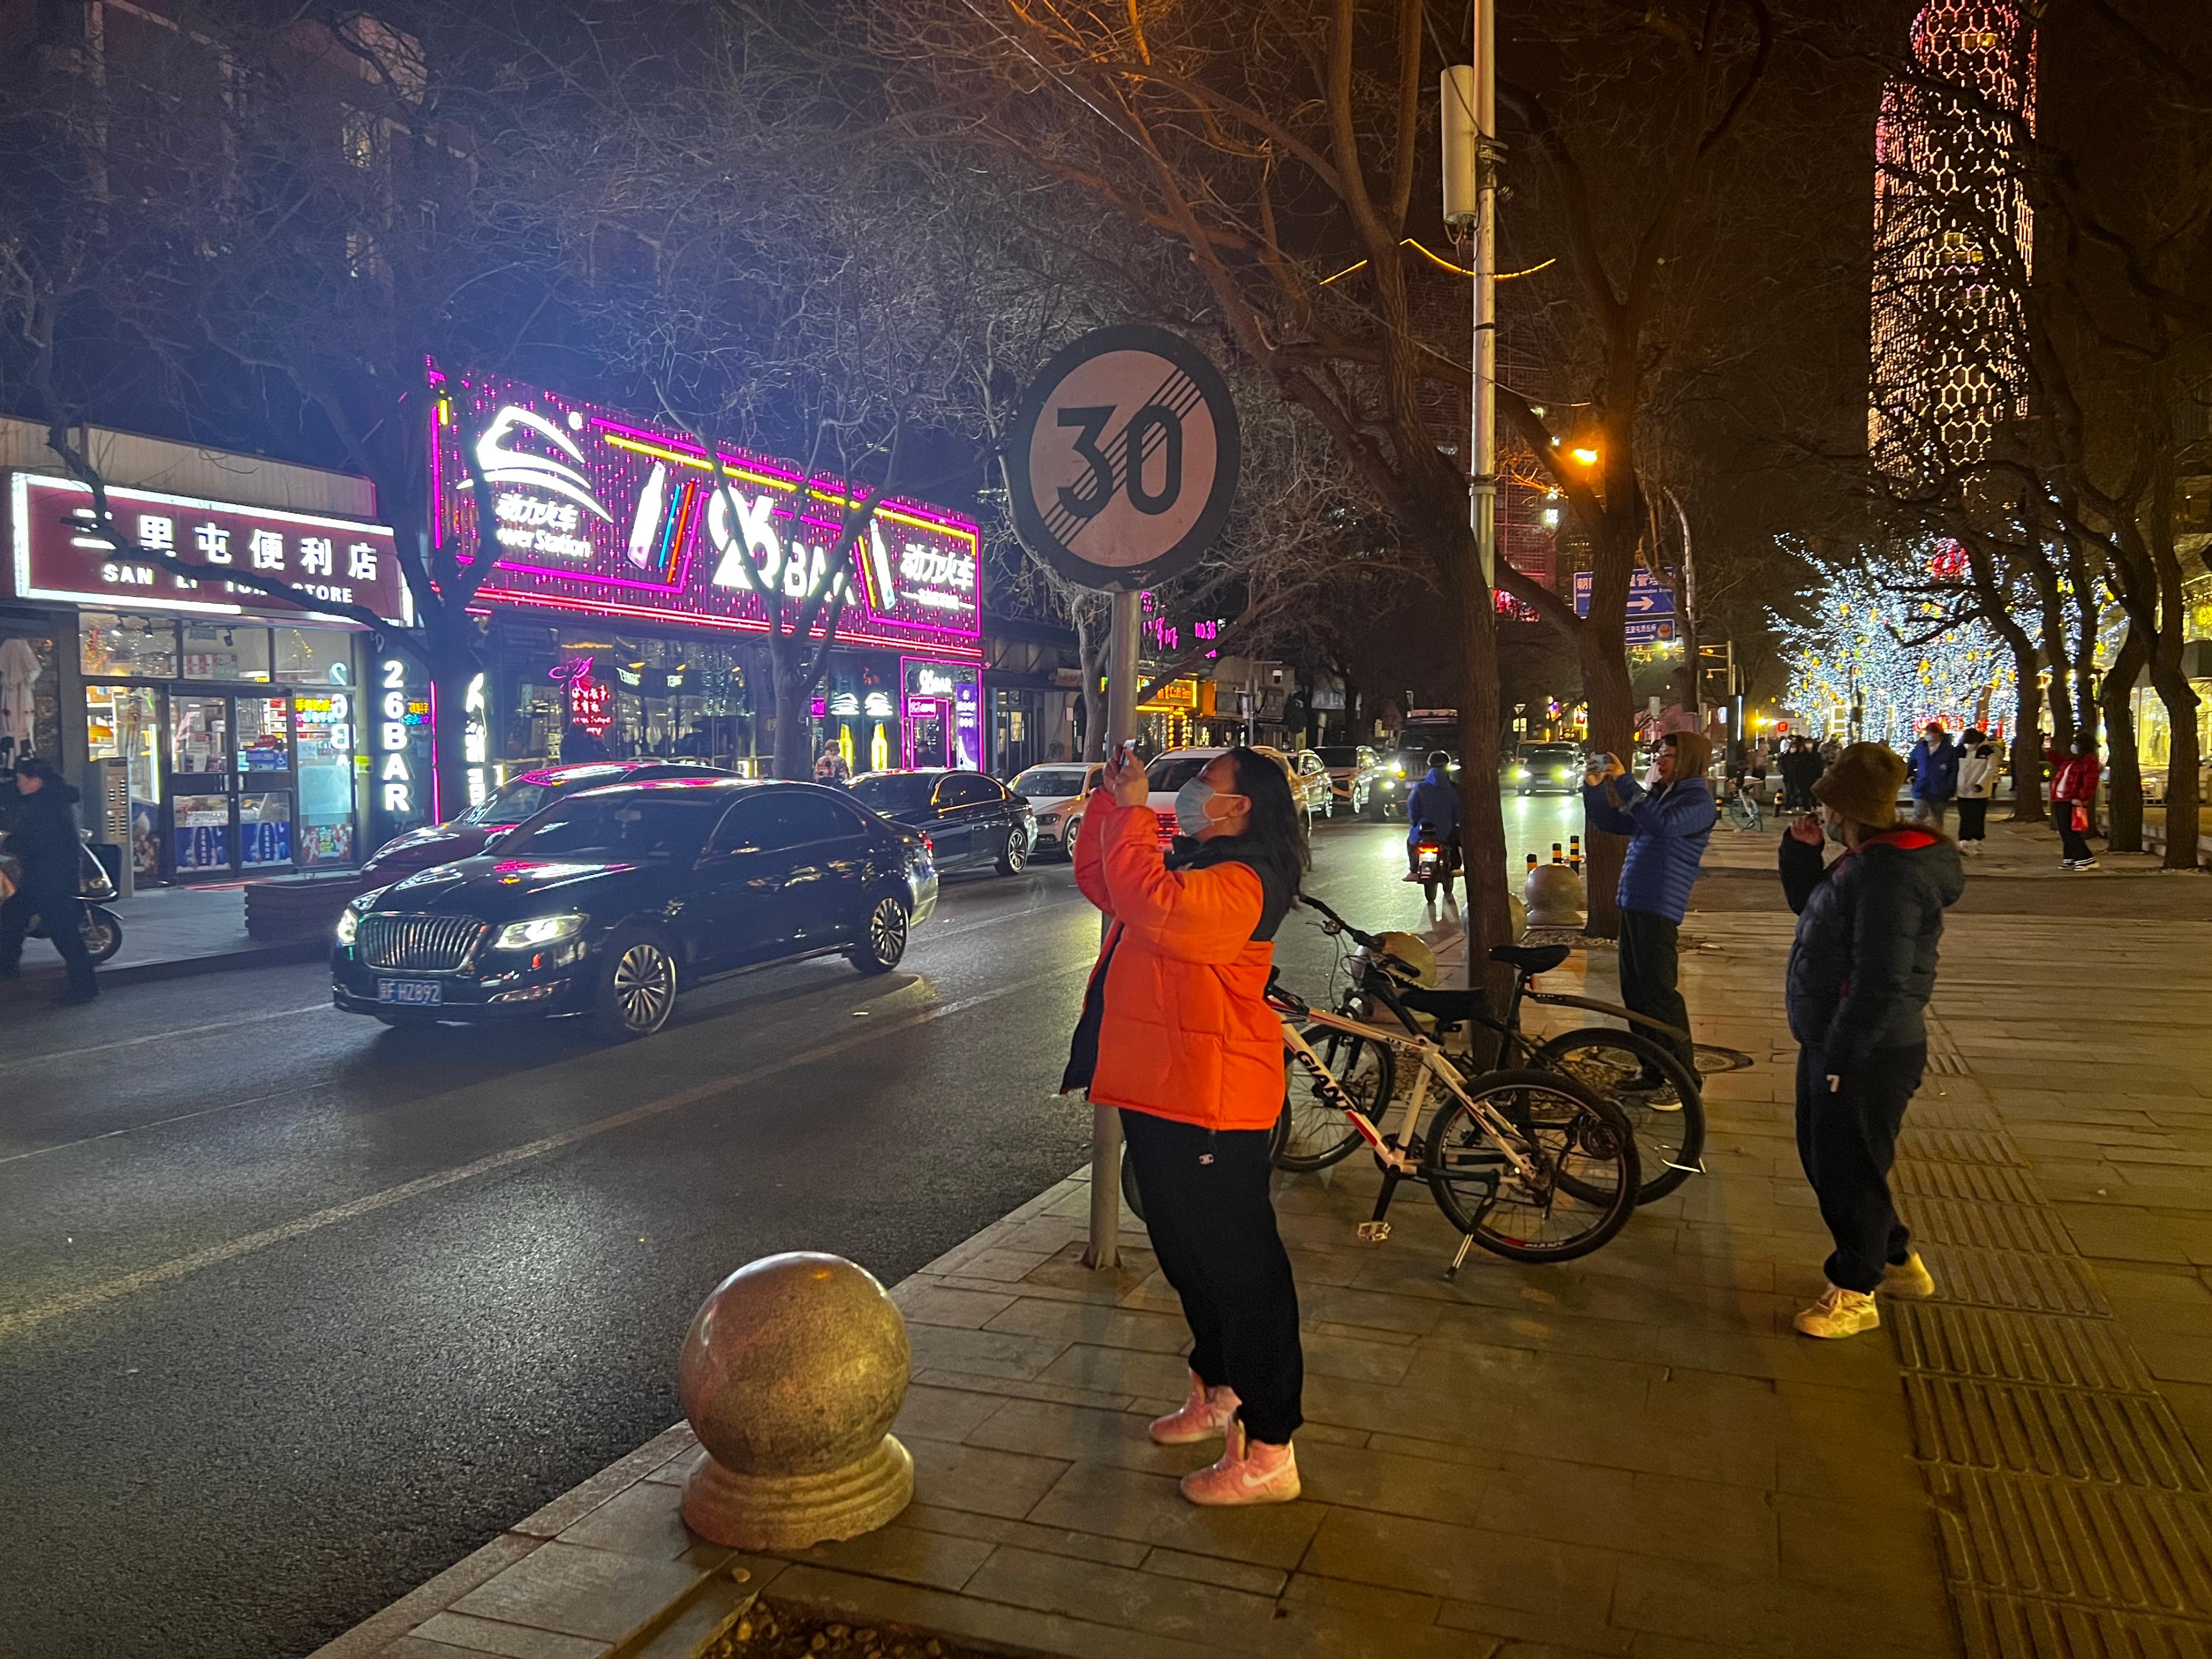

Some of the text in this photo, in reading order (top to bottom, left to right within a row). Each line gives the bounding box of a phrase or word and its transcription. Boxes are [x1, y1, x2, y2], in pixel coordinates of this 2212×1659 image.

[1057, 405, 1182, 518] 30
[495, 493, 579, 532] 动力火车
[71, 508, 378, 581] 三里屯便利店
[534, 530, 590, 557] Station
[900, 543, 976, 590] 动力火车
[104, 564, 153, 585] SAN
[383, 660, 409, 812] 26BAR
[1296, 1051, 1351, 1111] GIANT
